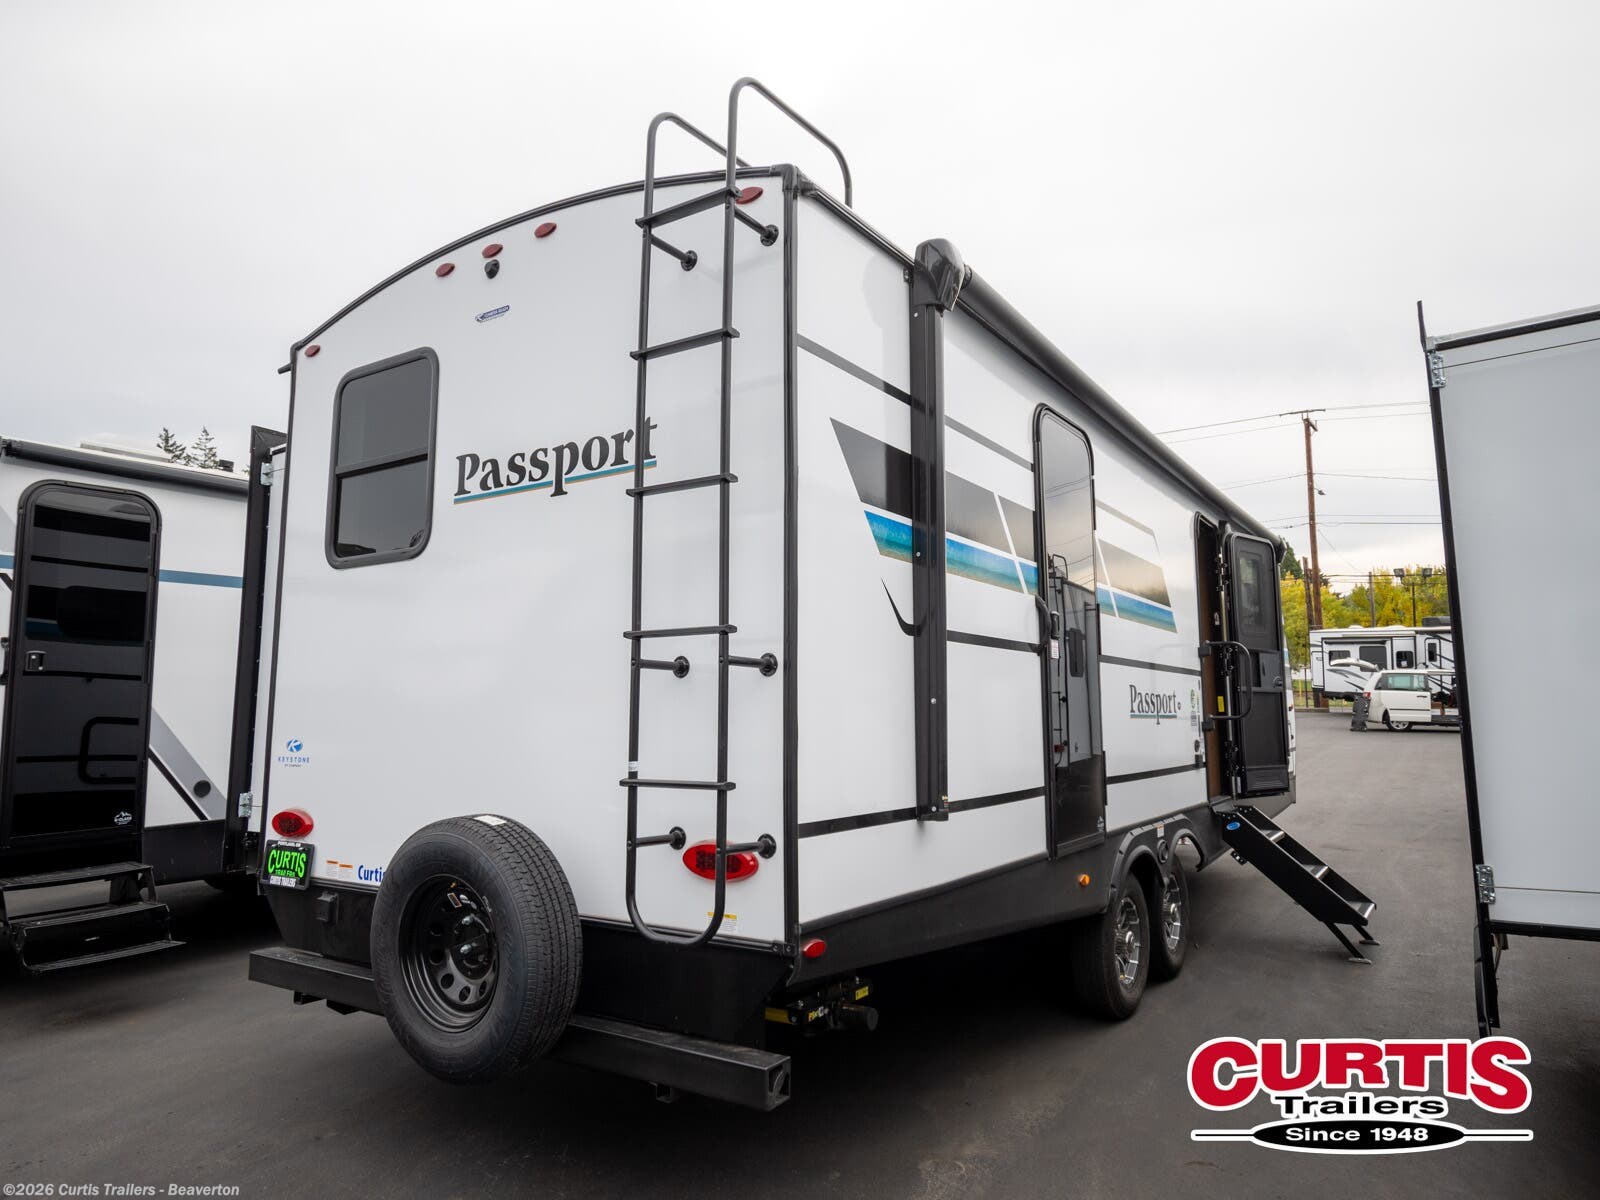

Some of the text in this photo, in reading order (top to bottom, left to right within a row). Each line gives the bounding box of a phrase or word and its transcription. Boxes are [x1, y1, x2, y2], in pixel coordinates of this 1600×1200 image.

[454, 416, 657, 498] Passport
[1128, 684, 1177, 726] Passport
[268, 849, 307, 878] CURTIS
